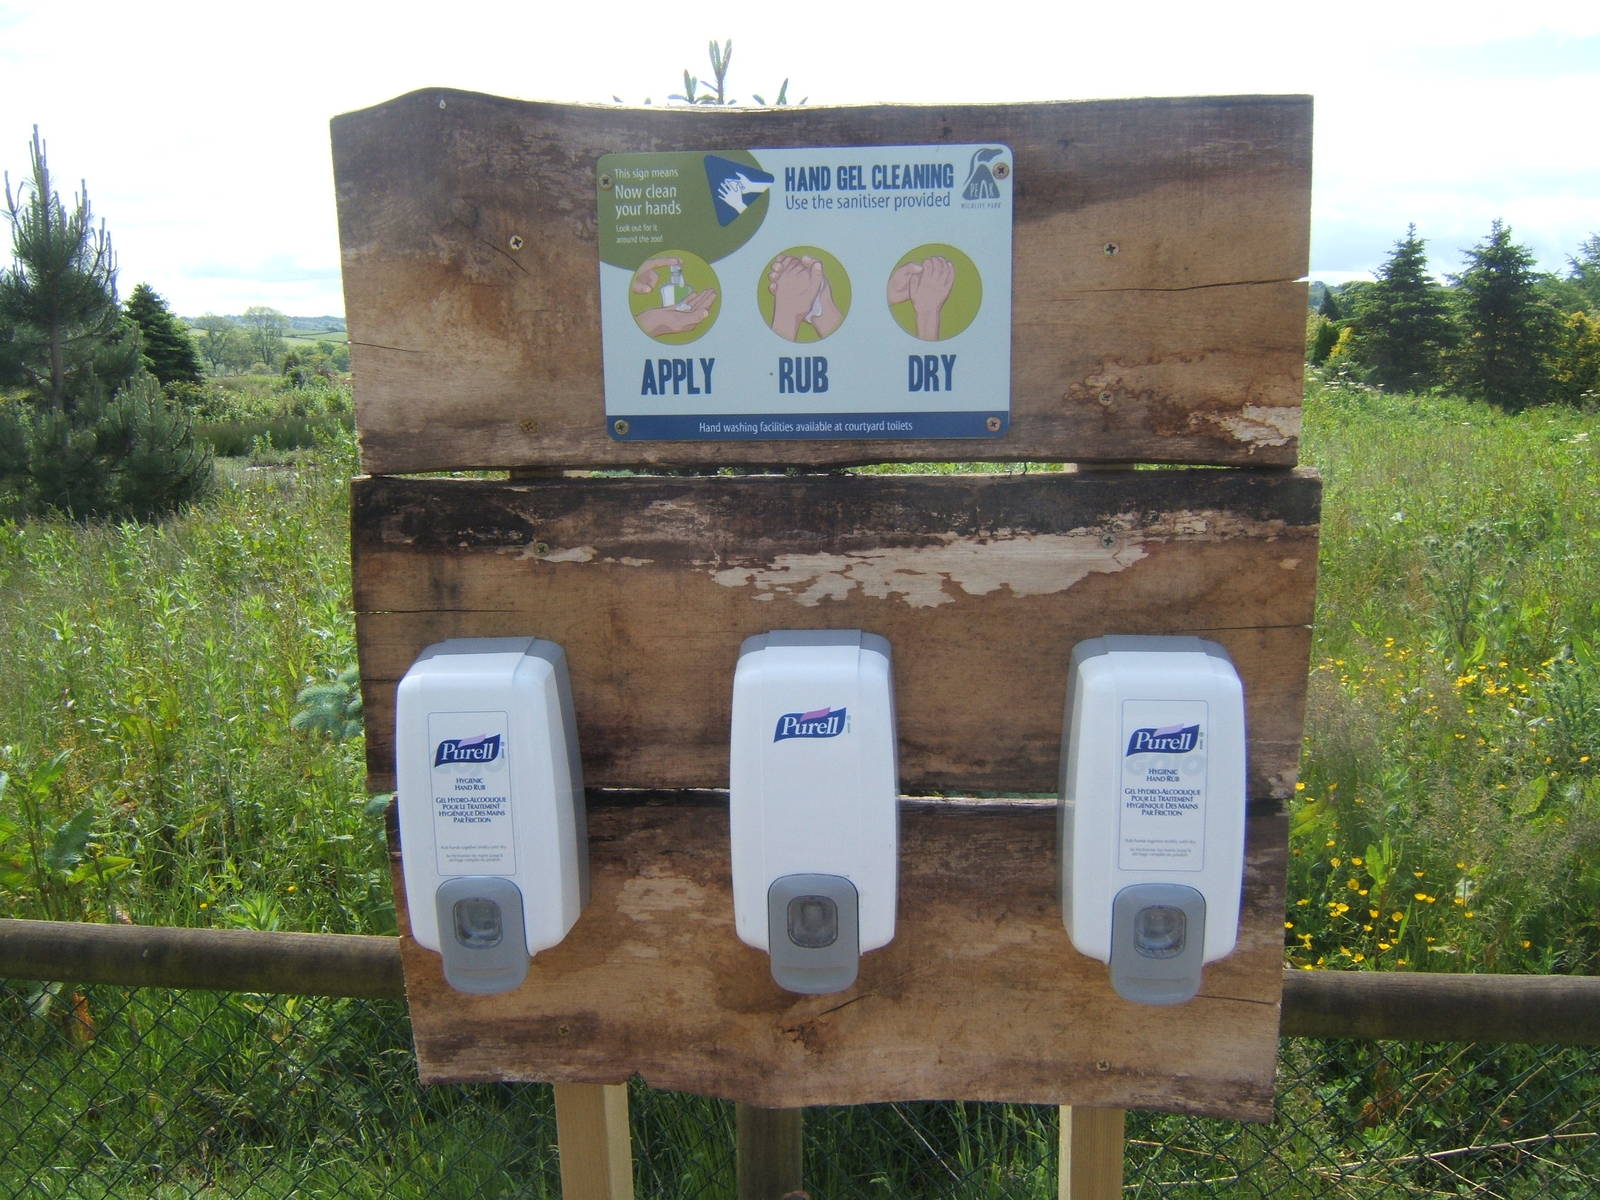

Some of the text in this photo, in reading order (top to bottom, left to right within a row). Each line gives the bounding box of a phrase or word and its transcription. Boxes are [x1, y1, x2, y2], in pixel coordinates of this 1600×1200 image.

[615, 168, 679, 181] This sign means
[785, 163, 954, 192] HAND GEL CLEANING
[615, 184, 677, 199] Now clean
[615, 201, 682, 219] your hands
[785, 192, 951, 211] Use the sanitiser provided
[616, 224, 658, 233] Look out for it
[616, 236, 638, 244] around
[639, 235, 650, 244] the
[641, 358, 715, 395] APPLY
[779, 356, 829, 393] RUB
[908, 354, 956, 392] DRY
[699, 420, 913, 435] Hand washing facilities available at courtyard toilets
[782, 716, 839, 735] Purell
[1135, 731, 1192, 750] Purell
[441, 742, 494, 761] Purell
